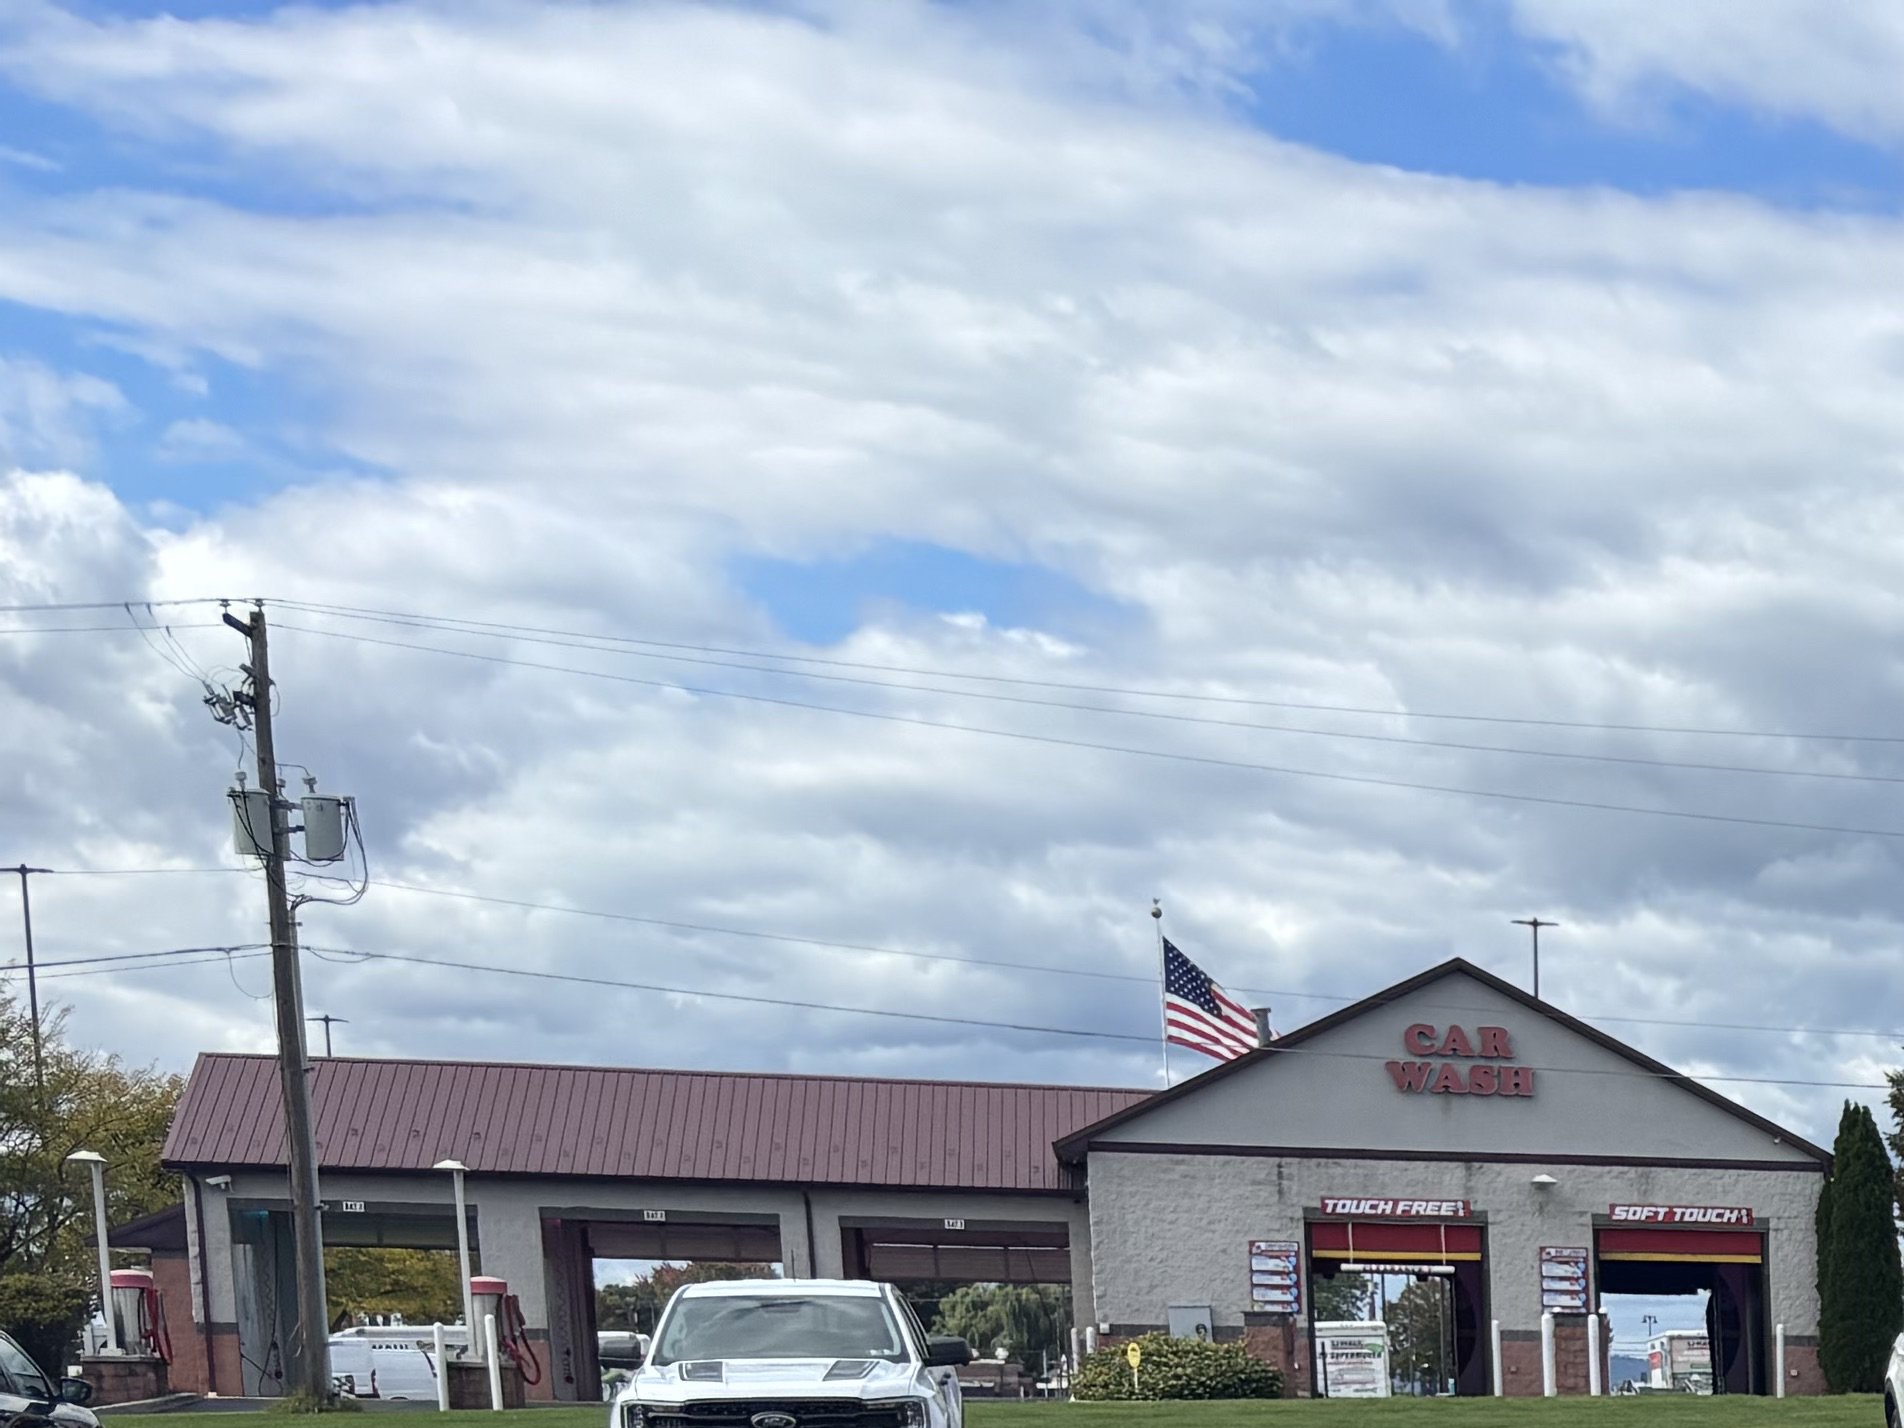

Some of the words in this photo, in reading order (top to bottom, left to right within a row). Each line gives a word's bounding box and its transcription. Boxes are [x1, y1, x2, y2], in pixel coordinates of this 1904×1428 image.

[1404, 1023, 1515, 1059] CAR
[1384, 1060, 1536, 1097] WASH
[1323, 1199, 1393, 1215] TOUCH
[1611, 1205, 1669, 1221] SOFT
[1672, 1207, 1738, 1223] TOUCH
